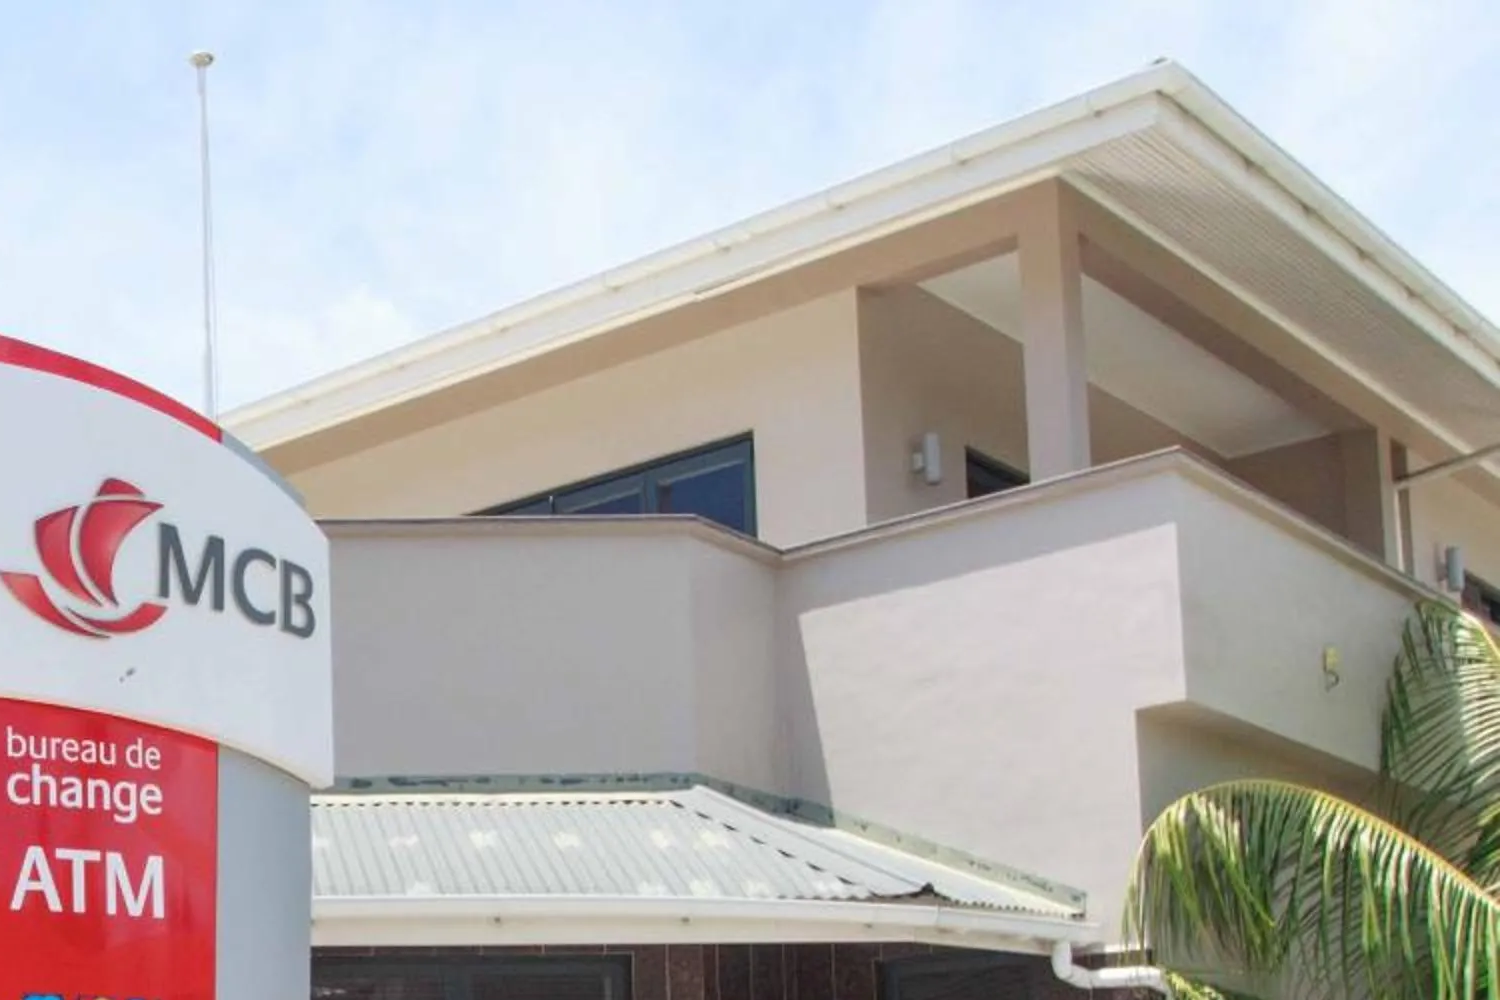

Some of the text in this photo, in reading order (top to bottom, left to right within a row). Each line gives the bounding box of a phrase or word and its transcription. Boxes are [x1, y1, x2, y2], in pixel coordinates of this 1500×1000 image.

[157, 522, 316, 639] MCB
[6, 725, 162, 770] bureau de
[6, 762, 164, 824] change
[9, 845, 166, 919] ATM
